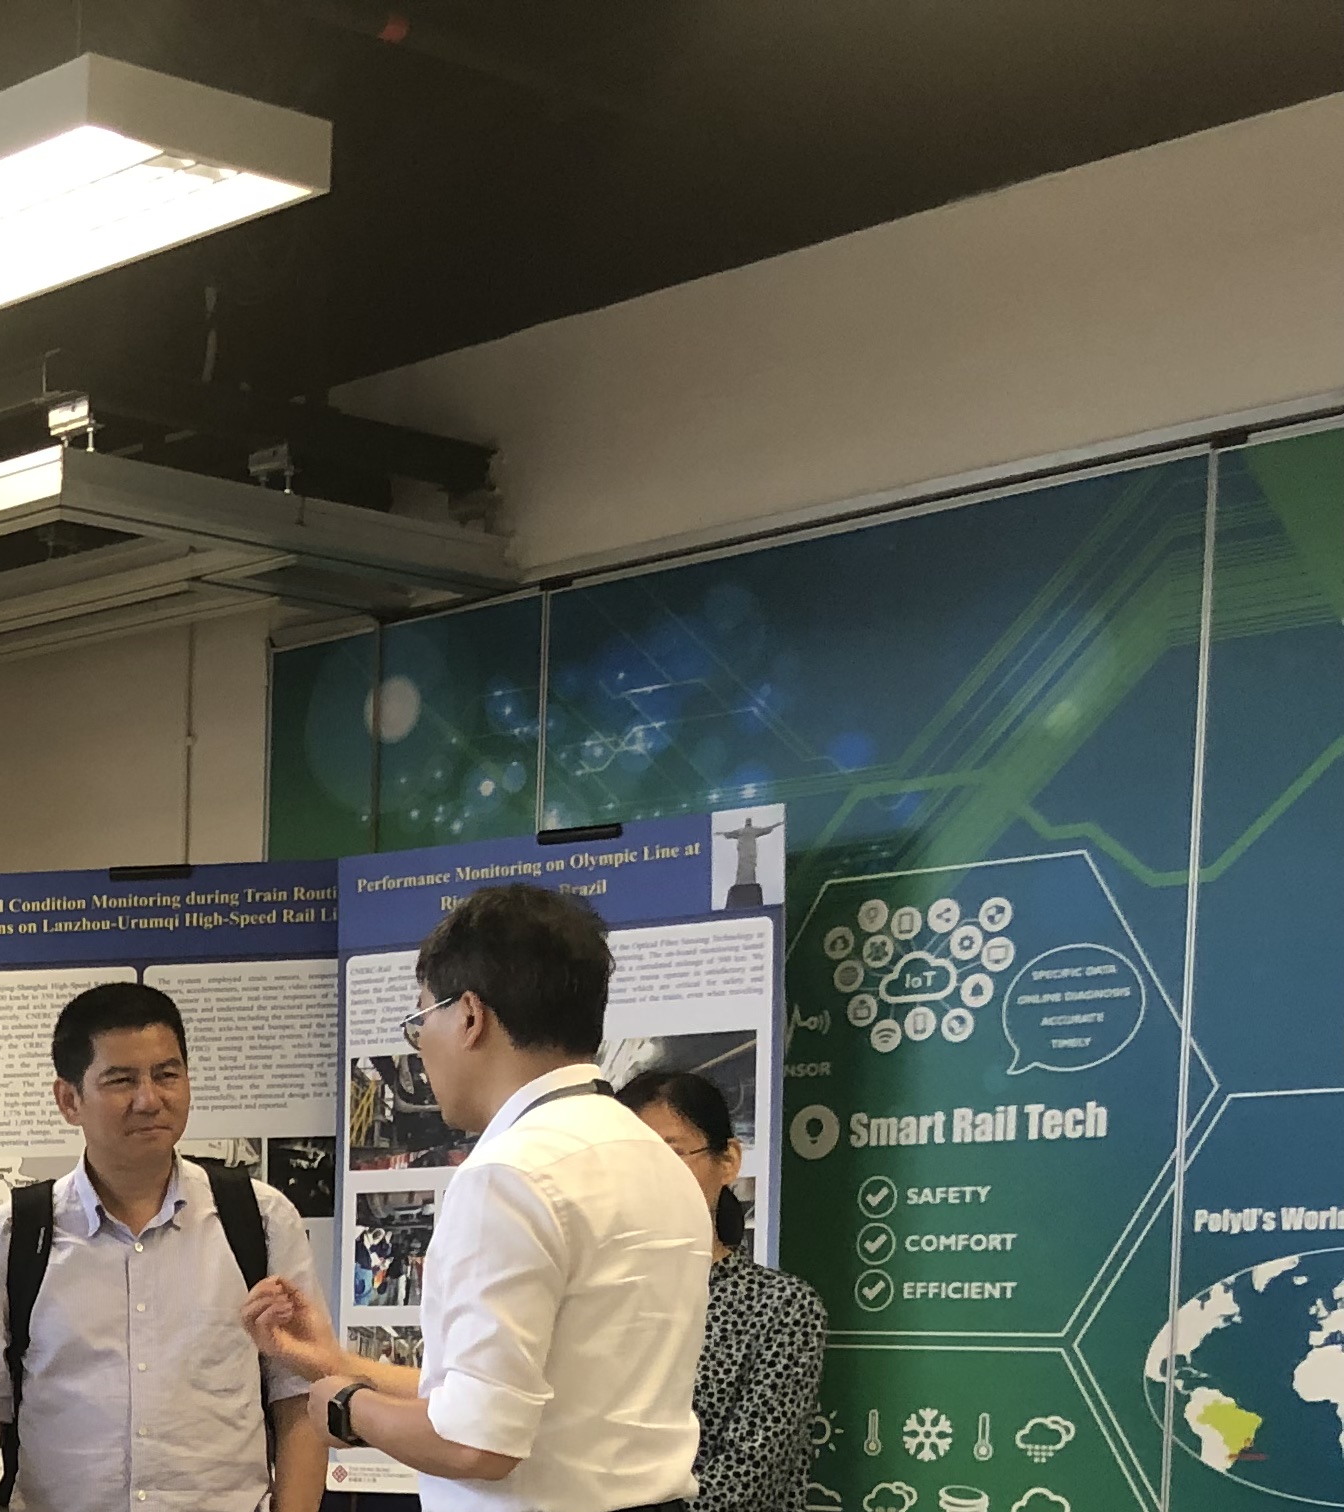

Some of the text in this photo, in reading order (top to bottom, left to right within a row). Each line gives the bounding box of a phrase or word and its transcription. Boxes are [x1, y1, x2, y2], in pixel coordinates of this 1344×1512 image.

[357, 842, 700, 893] Performance Monitoring on Olympic Line at
[9, 896, 85, 913] Condition
[92, 892, 181, 911] Monitoring
[186, 890, 239, 906] during
[244, 887, 287, 902] Train
[294, 885, 337, 900] Routi
[19, 921, 37, 933] on
[43, 913, 179, 931] Lanzhou-Urumqi
[185, 910, 276, 929] High-Speed
[283, 909, 314, 922] Rail
[321, 907, 337, 921] Li
[905, 971, 936, 988] IoT
[784, 1062, 831, 1077] NSOR
[849, 1100, 1108, 1148] Smart Rail Tech
[907, 1185, 992, 1205] SAFETY
[1194, 1209, 1276, 1234] PolyU's
[904, 1233, 1018, 1252] COMFORT
[903, 1281, 1018, 1300] EFFICIENT
